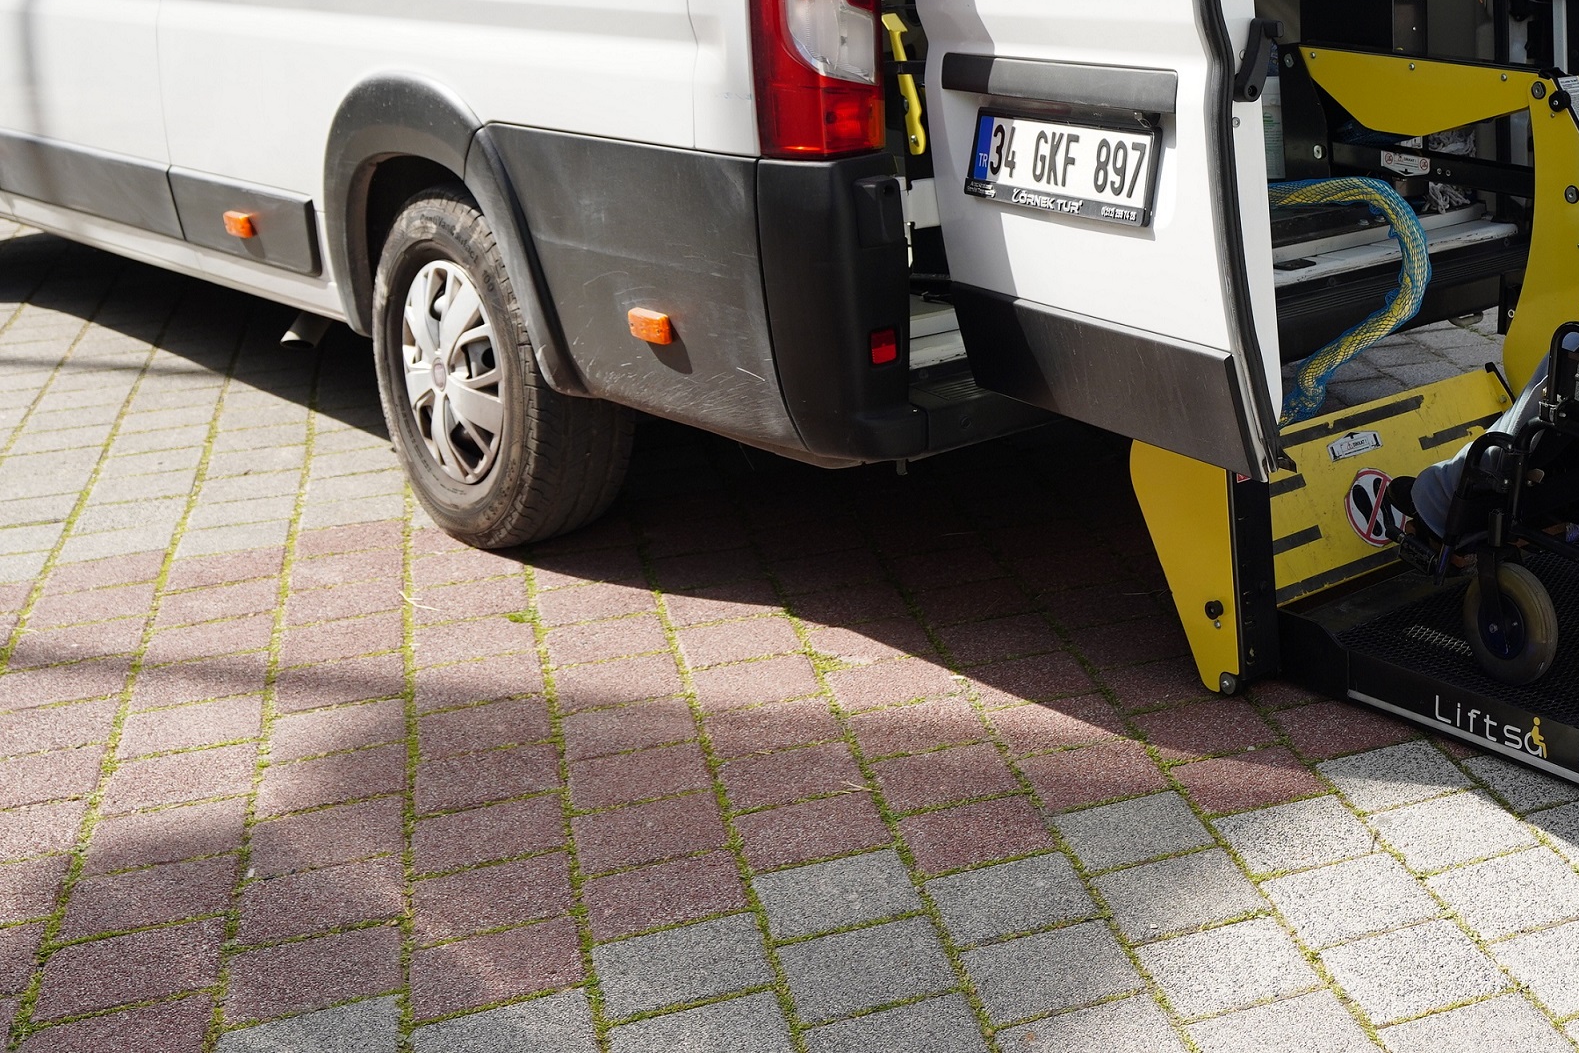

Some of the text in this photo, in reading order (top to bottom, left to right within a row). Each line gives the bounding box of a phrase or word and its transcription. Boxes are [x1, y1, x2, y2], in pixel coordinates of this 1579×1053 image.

[978, 152, 988, 168] TR
[989, 123, 1147, 198] 34 GKF 897
[1018, 189, 1056, 210] ÖRNEK
[1056, 199, 1080, 215] TUR
